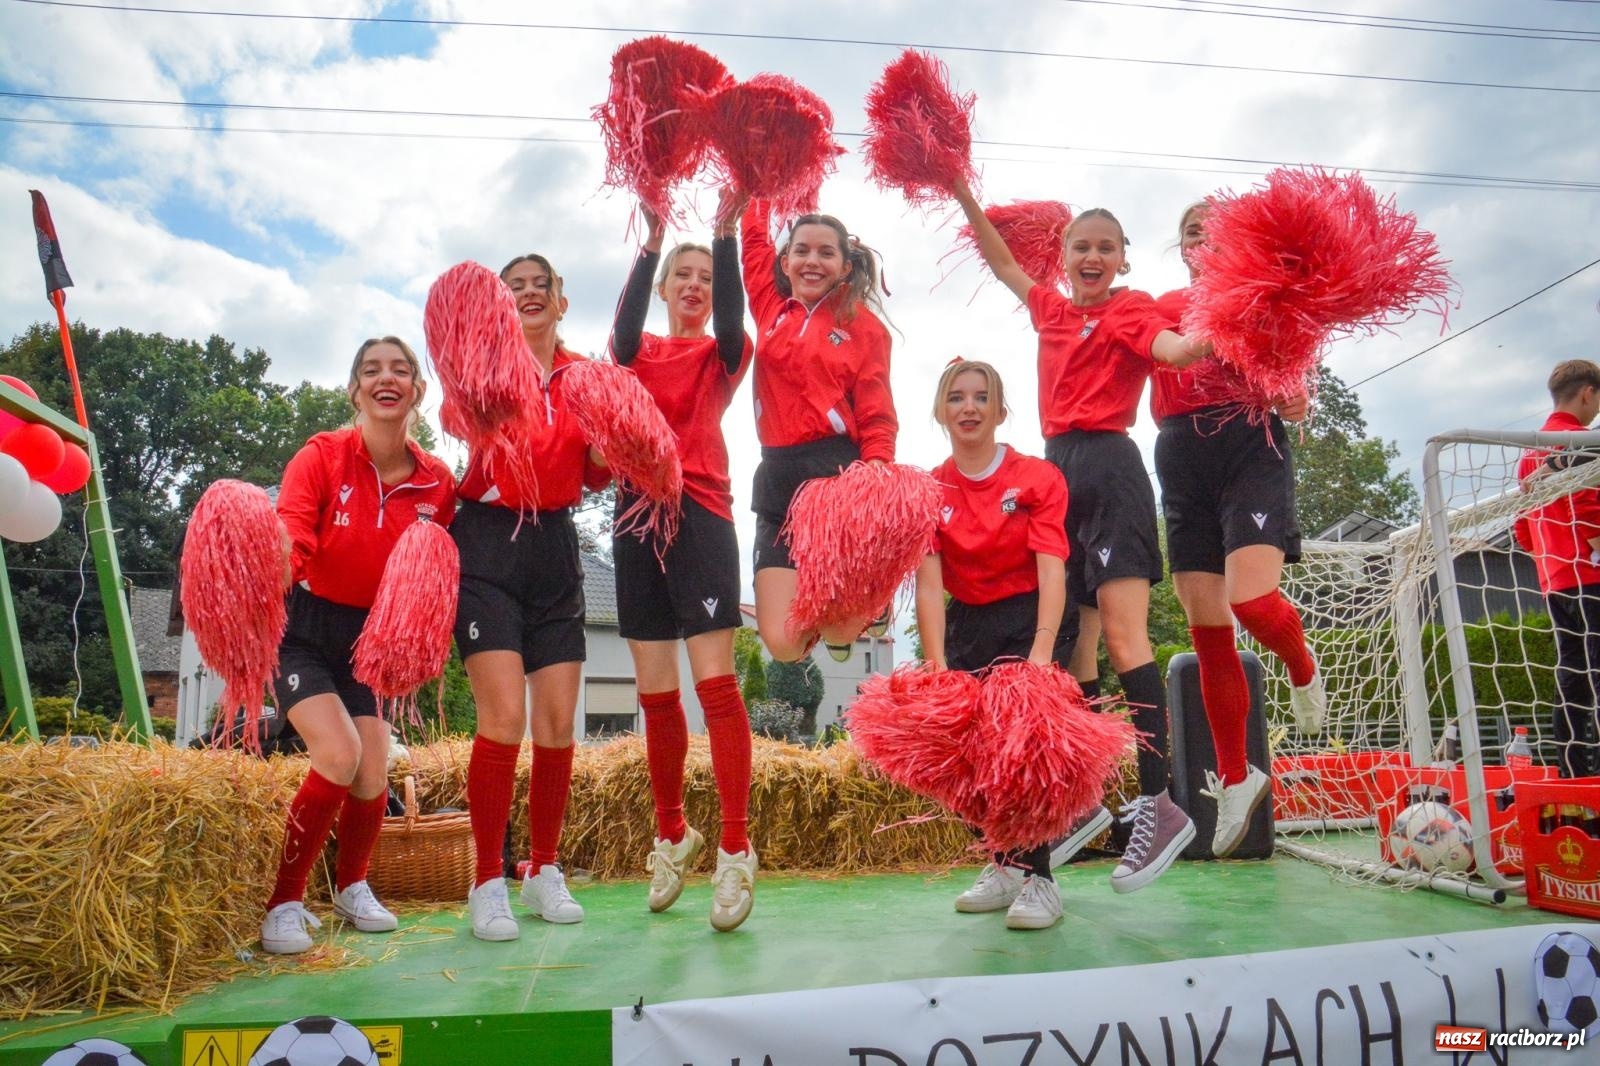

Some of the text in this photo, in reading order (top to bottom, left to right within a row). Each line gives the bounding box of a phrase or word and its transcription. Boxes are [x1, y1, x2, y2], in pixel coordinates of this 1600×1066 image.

[333, 510, 350, 526] 16
[468, 621, 480, 640] 6
[287, 673, 300, 692] 9
[1539, 870, 1600, 904] TYSKI
